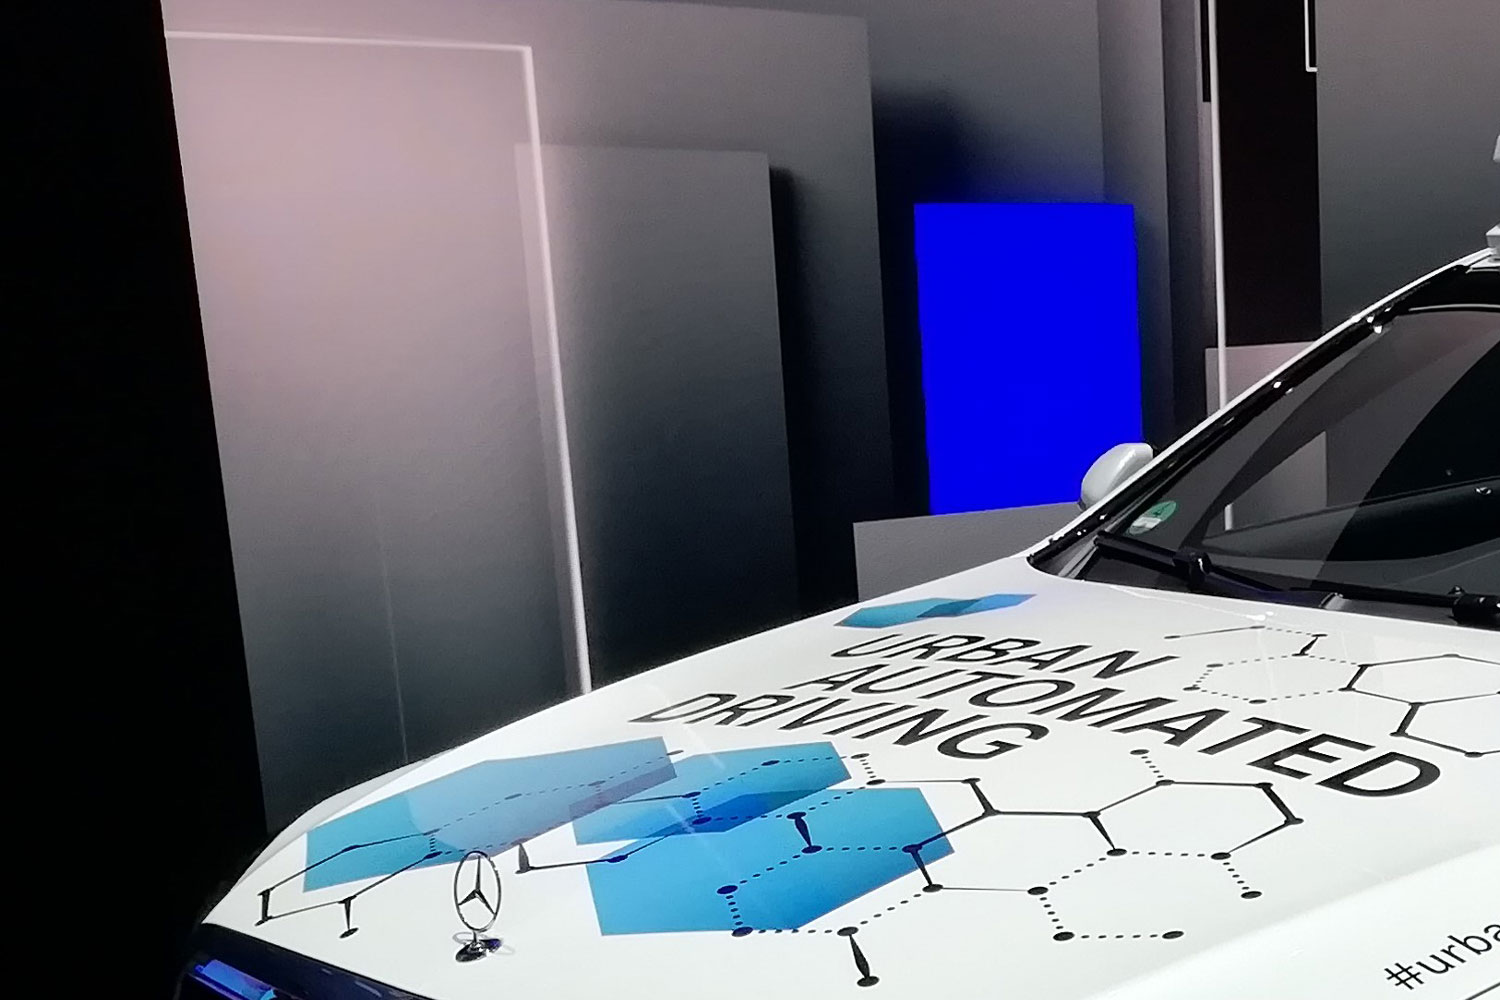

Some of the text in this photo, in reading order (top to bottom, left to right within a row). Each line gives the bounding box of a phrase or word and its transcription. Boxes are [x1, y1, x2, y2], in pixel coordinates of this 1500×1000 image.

[830, 631, 1179, 680] URBAN
[628, 692, 1051, 760] DRIVING
[788, 663, 1443, 798] AUTOMATED
